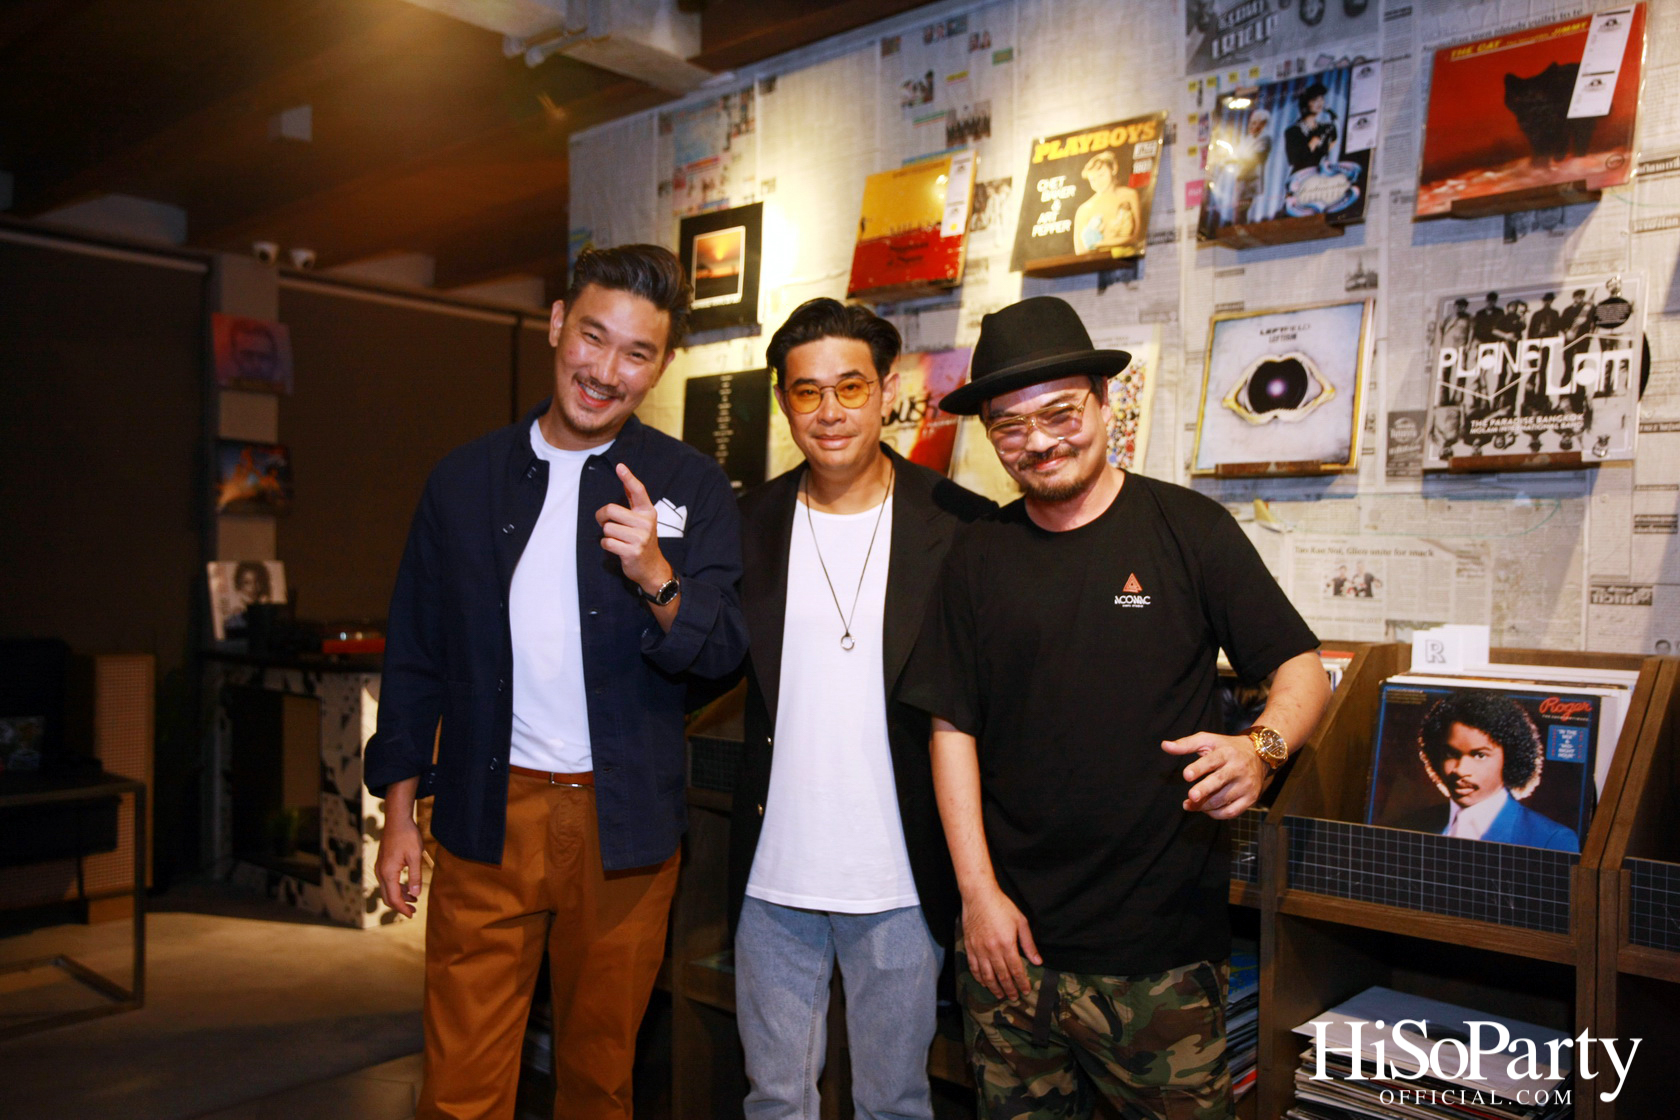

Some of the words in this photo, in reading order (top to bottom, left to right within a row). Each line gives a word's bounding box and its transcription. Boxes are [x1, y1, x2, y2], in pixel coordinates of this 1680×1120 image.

[1552, 21, 1588, 37] JIMMY
[1477, 38, 1503, 52] CAT
[1032, 121, 1157, 164] PLAYBOYS
[1036, 175, 1067, 192] CHET
[1040, 185, 1077, 202] BAKER
[1036, 210, 1059, 225] ART
[1031, 219, 1072, 237] PEPPER
[1438, 336, 1566, 386] PLANET
[1470, 419, 1488, 428] THE
[1489, 416, 1536, 426] PARADISE
[1535, 413, 1584, 424] BANGKOK
[1425, 639, 1447, 664] R
[1539, 697, 1593, 721] Roger
